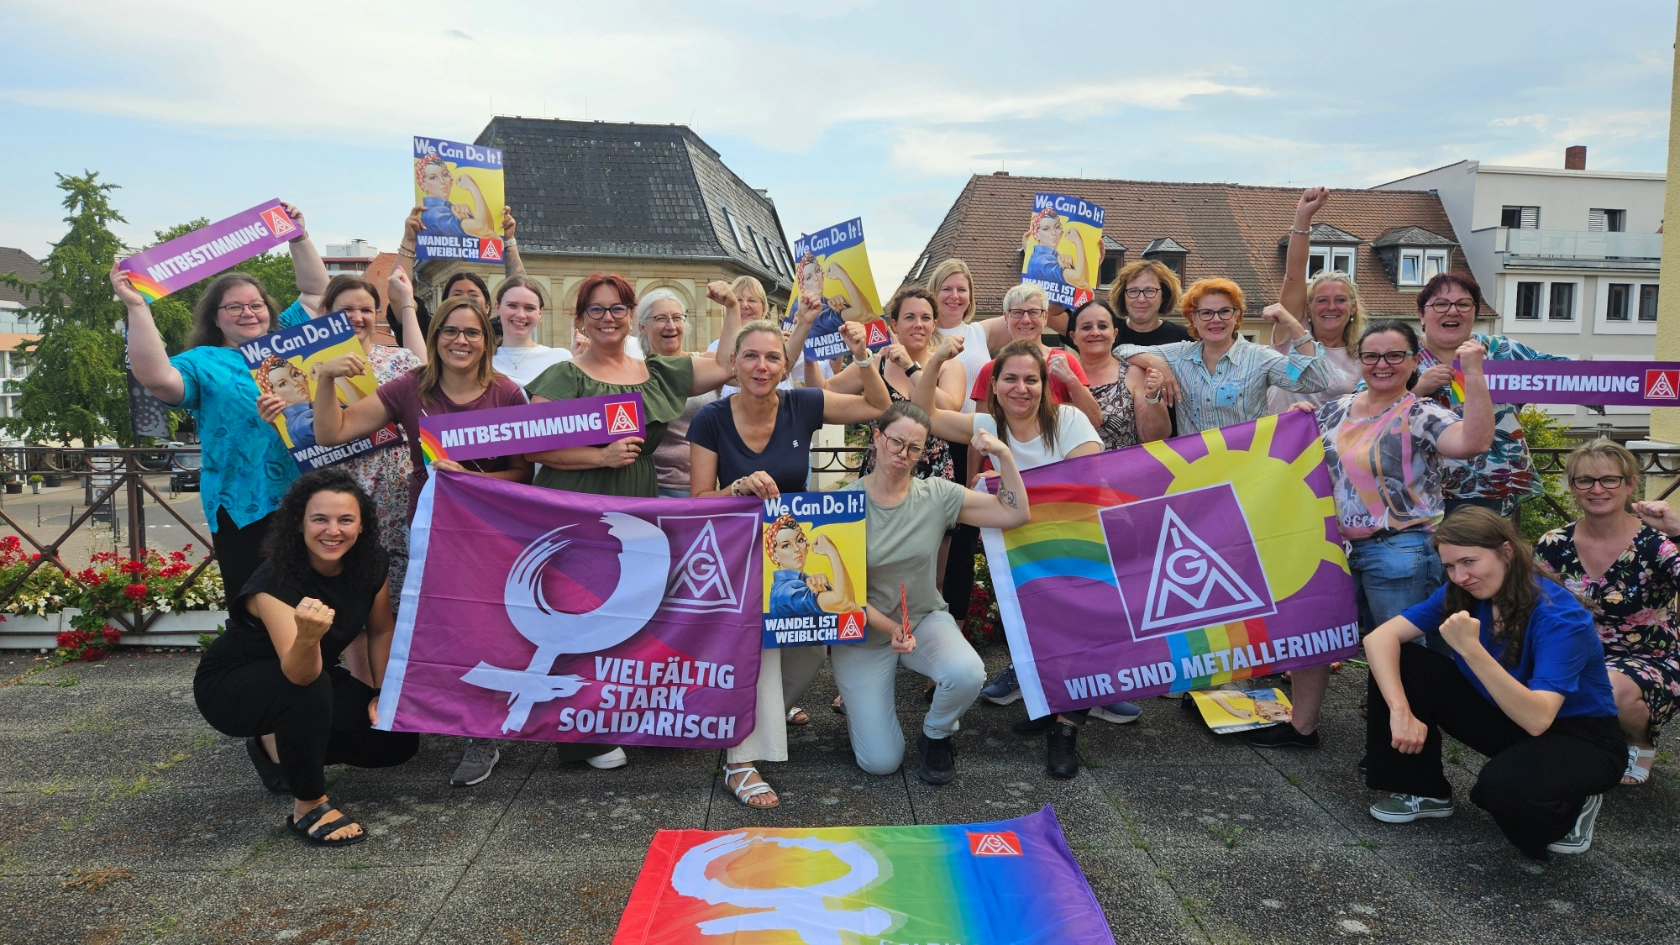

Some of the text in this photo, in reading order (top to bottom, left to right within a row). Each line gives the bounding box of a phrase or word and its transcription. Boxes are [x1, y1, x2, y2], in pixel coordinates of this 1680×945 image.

[414, 138, 502, 165] We Can Do It!
[1035, 195, 1105, 224] We Can Do It!
[147, 221, 269, 283] MITBESTIMMUNG
[417, 235, 479, 249] WANDEL IST
[426, 246, 479, 259] WEIBLICH!
[795, 219, 862, 258] We Can Do It!
[1047, 290, 1074, 306] BLICH!
[1061, 284, 1076, 296] IST
[240, 312, 352, 364] We Can Do It!
[441, 412, 602, 449] MITBESTIMMUNG
[309, 437, 374, 469] WEIBLICH!
[764, 493, 865, 517] We Can Do It!
[764, 615, 838, 631] WANDEL IST
[775, 628, 838, 644] WEIBLICH!
[594, 656, 735, 690] VIELFÄLTIG
[1063, 620, 1360, 701] WIR SIND METALLERINNEN
[598, 684, 688, 711] STARK
[557, 707, 737, 740] SOLIDARISCH
